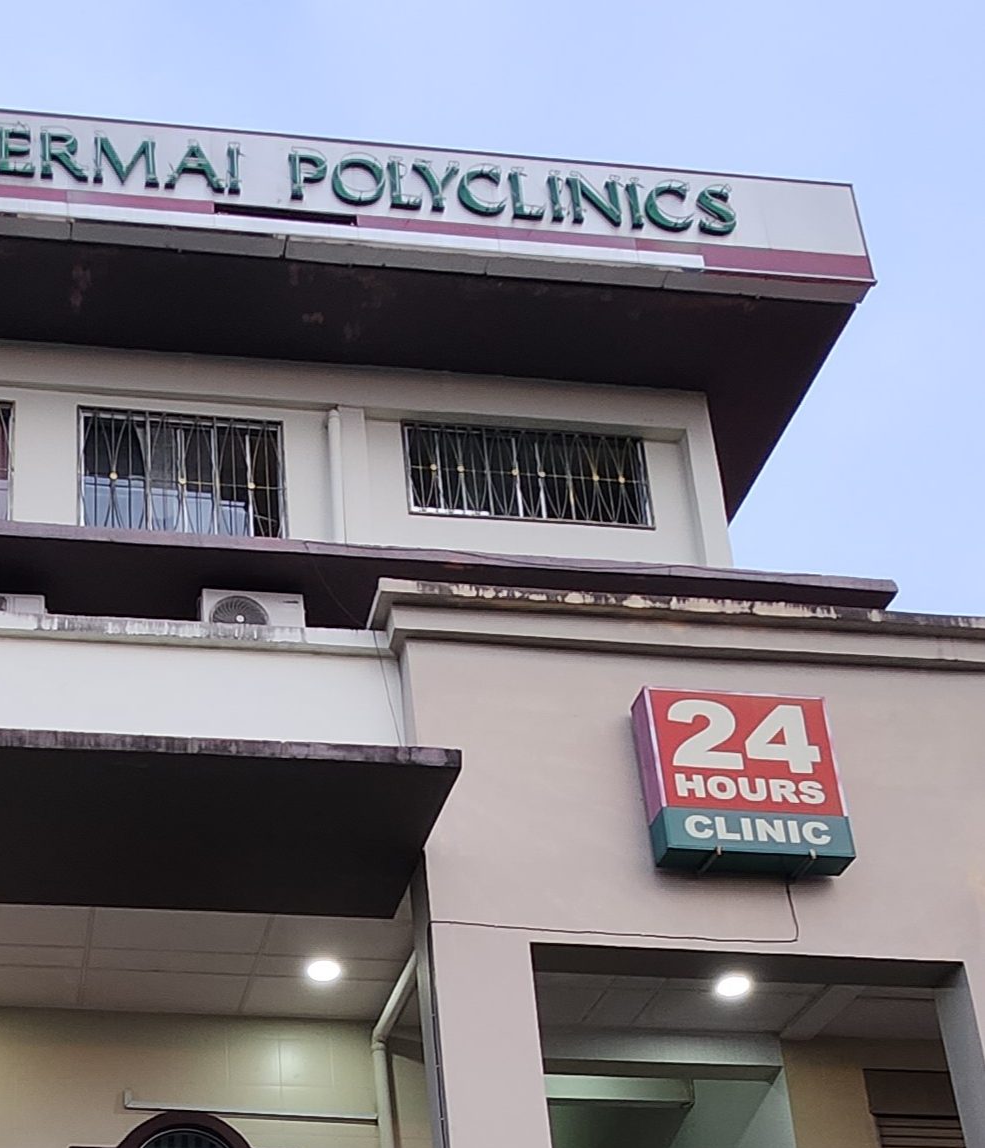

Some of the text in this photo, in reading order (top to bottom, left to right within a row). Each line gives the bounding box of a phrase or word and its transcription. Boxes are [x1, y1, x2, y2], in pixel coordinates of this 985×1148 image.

[288, 147, 738, 236] POLYCLINICS
[667, 699, 822, 774] 24
[674, 773, 826, 804] HOURS
[684, 814, 832, 845] CLINIC
